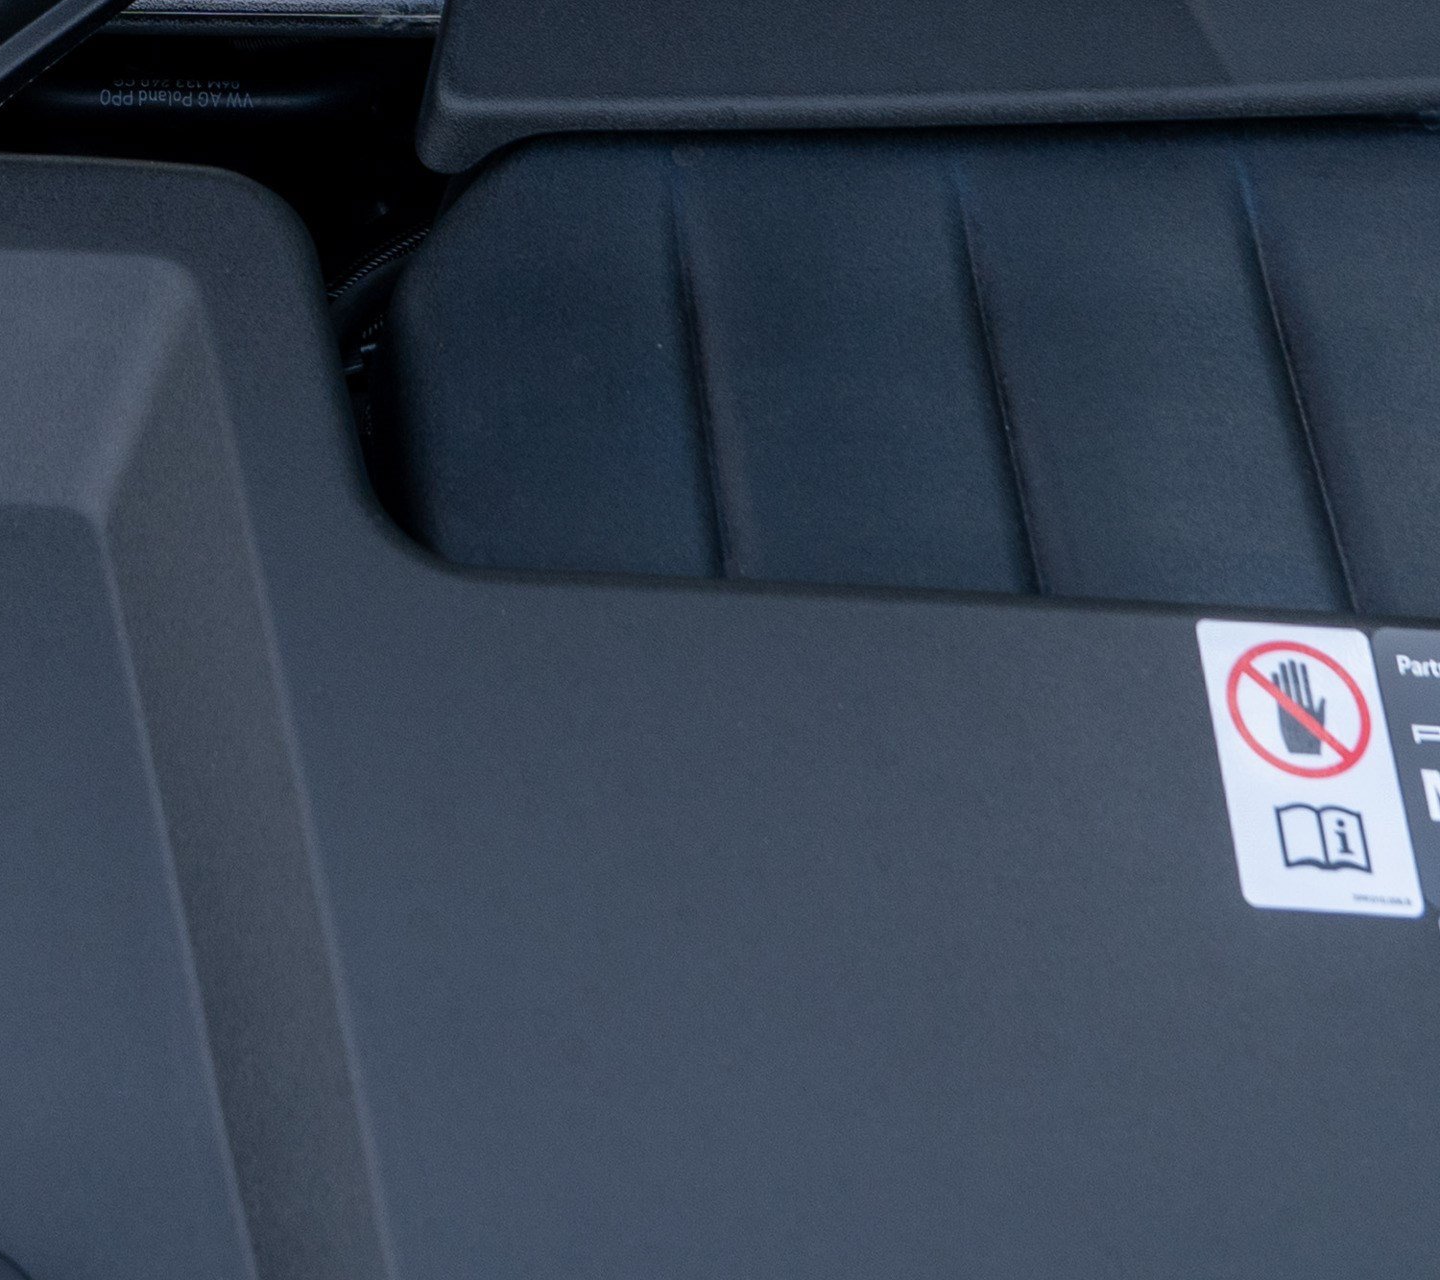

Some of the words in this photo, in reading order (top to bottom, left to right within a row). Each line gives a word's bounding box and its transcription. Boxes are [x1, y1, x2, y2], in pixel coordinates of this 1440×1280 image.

[138, 89, 193, 107] Poland
[198, 91, 221, 108] AG
[226, 91, 254, 109] VW
